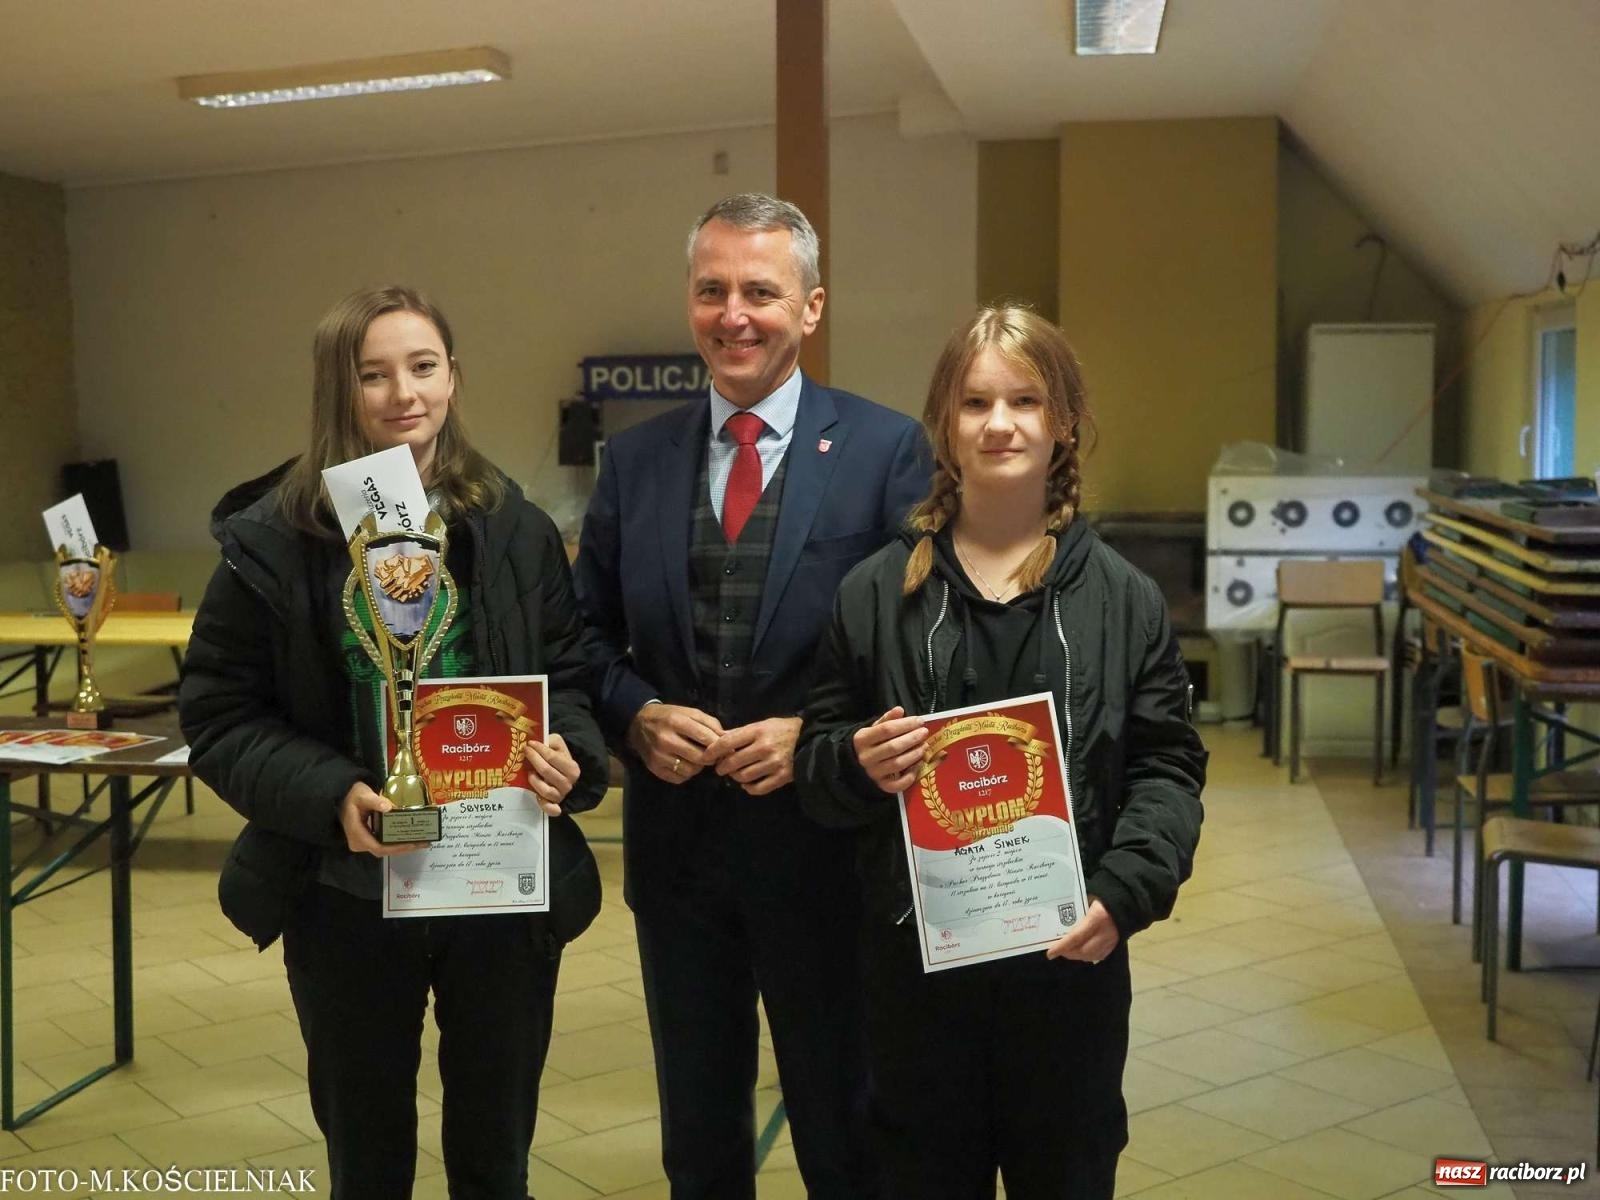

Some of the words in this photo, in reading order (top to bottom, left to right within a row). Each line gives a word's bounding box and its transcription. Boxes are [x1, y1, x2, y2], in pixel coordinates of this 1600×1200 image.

[363, 476, 387, 520] VEGAS
[441, 743, 491, 754] Racibórz
[958, 774, 1009, 792] Racibórz
[951, 797, 1026, 830] DYPLOM
[954, 844, 985, 857] AGATA
